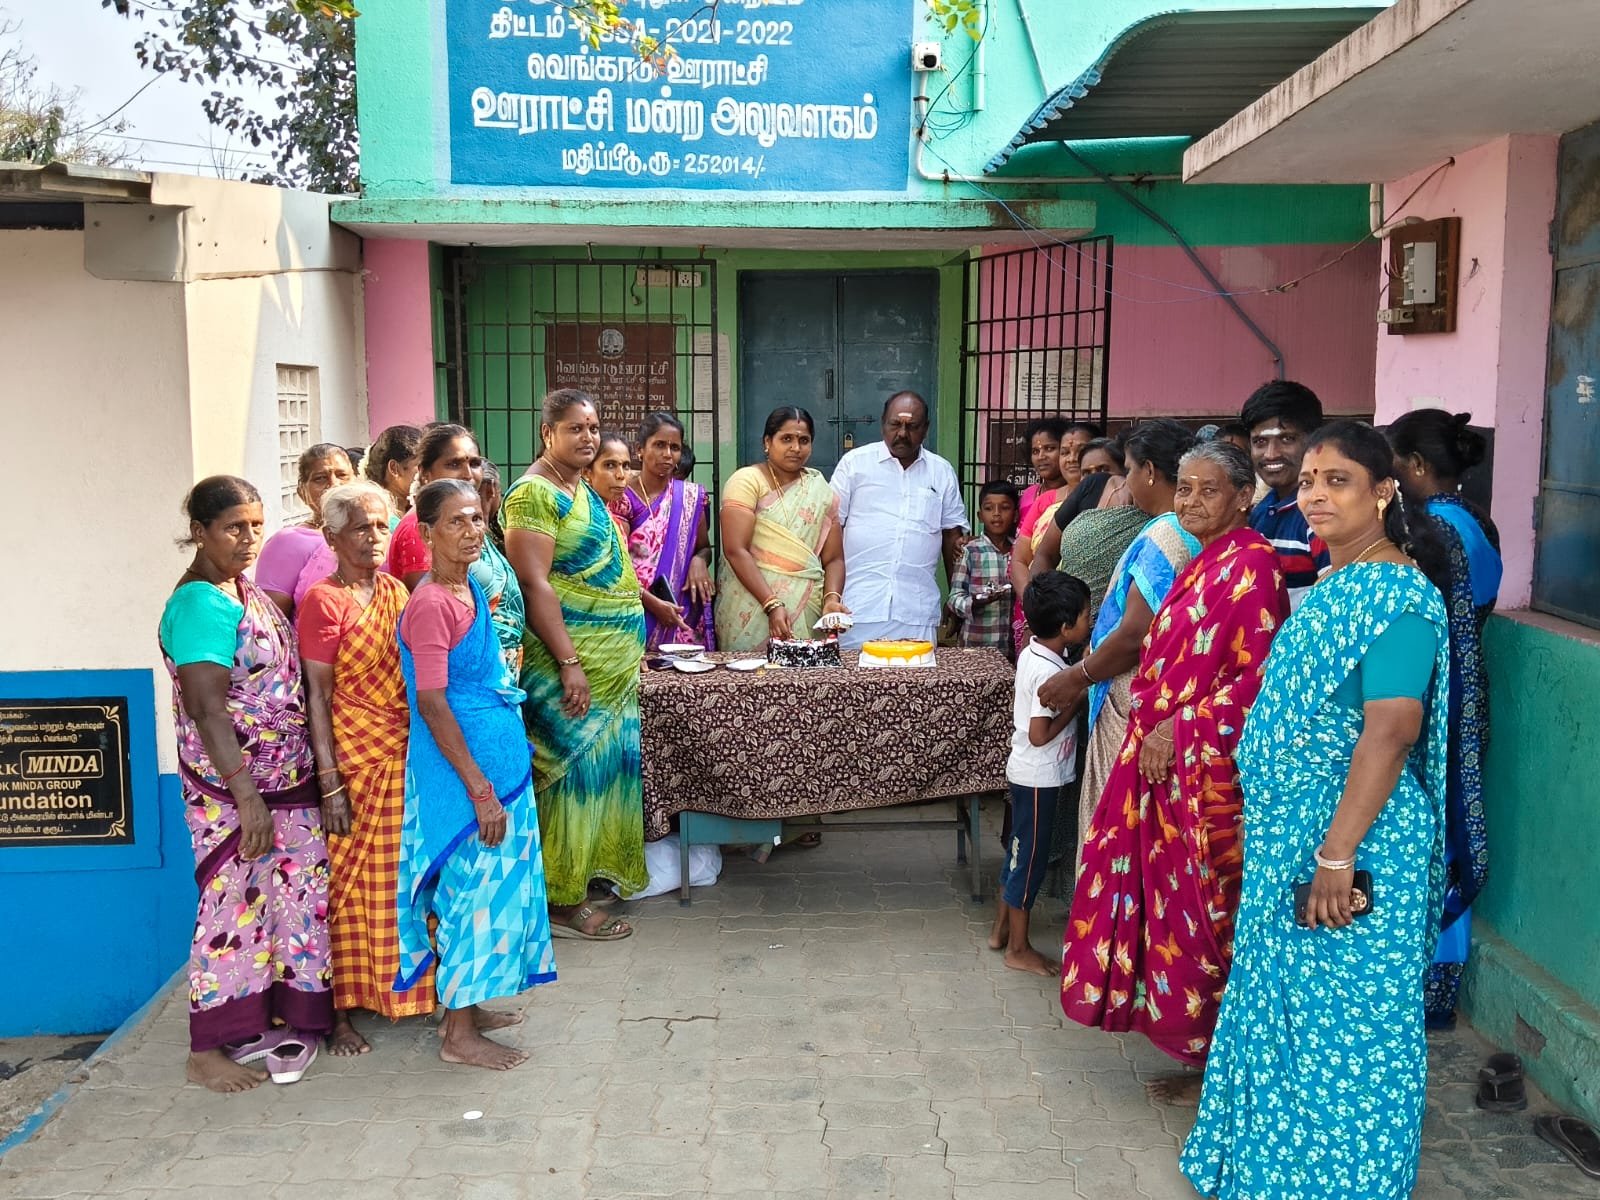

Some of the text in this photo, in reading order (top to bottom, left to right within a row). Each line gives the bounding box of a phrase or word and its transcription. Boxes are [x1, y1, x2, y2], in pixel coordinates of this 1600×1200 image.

[666, 53, 769, 89] ஊராட்சி
[471, 86, 615, 136] ஊராட்சி
[625, 85, 705, 142] மன்ற
[26, 754, 99, 774] MINDA
[12, 781, 44, 791] MINDA
[46, 780, 82, 790] GROUP
